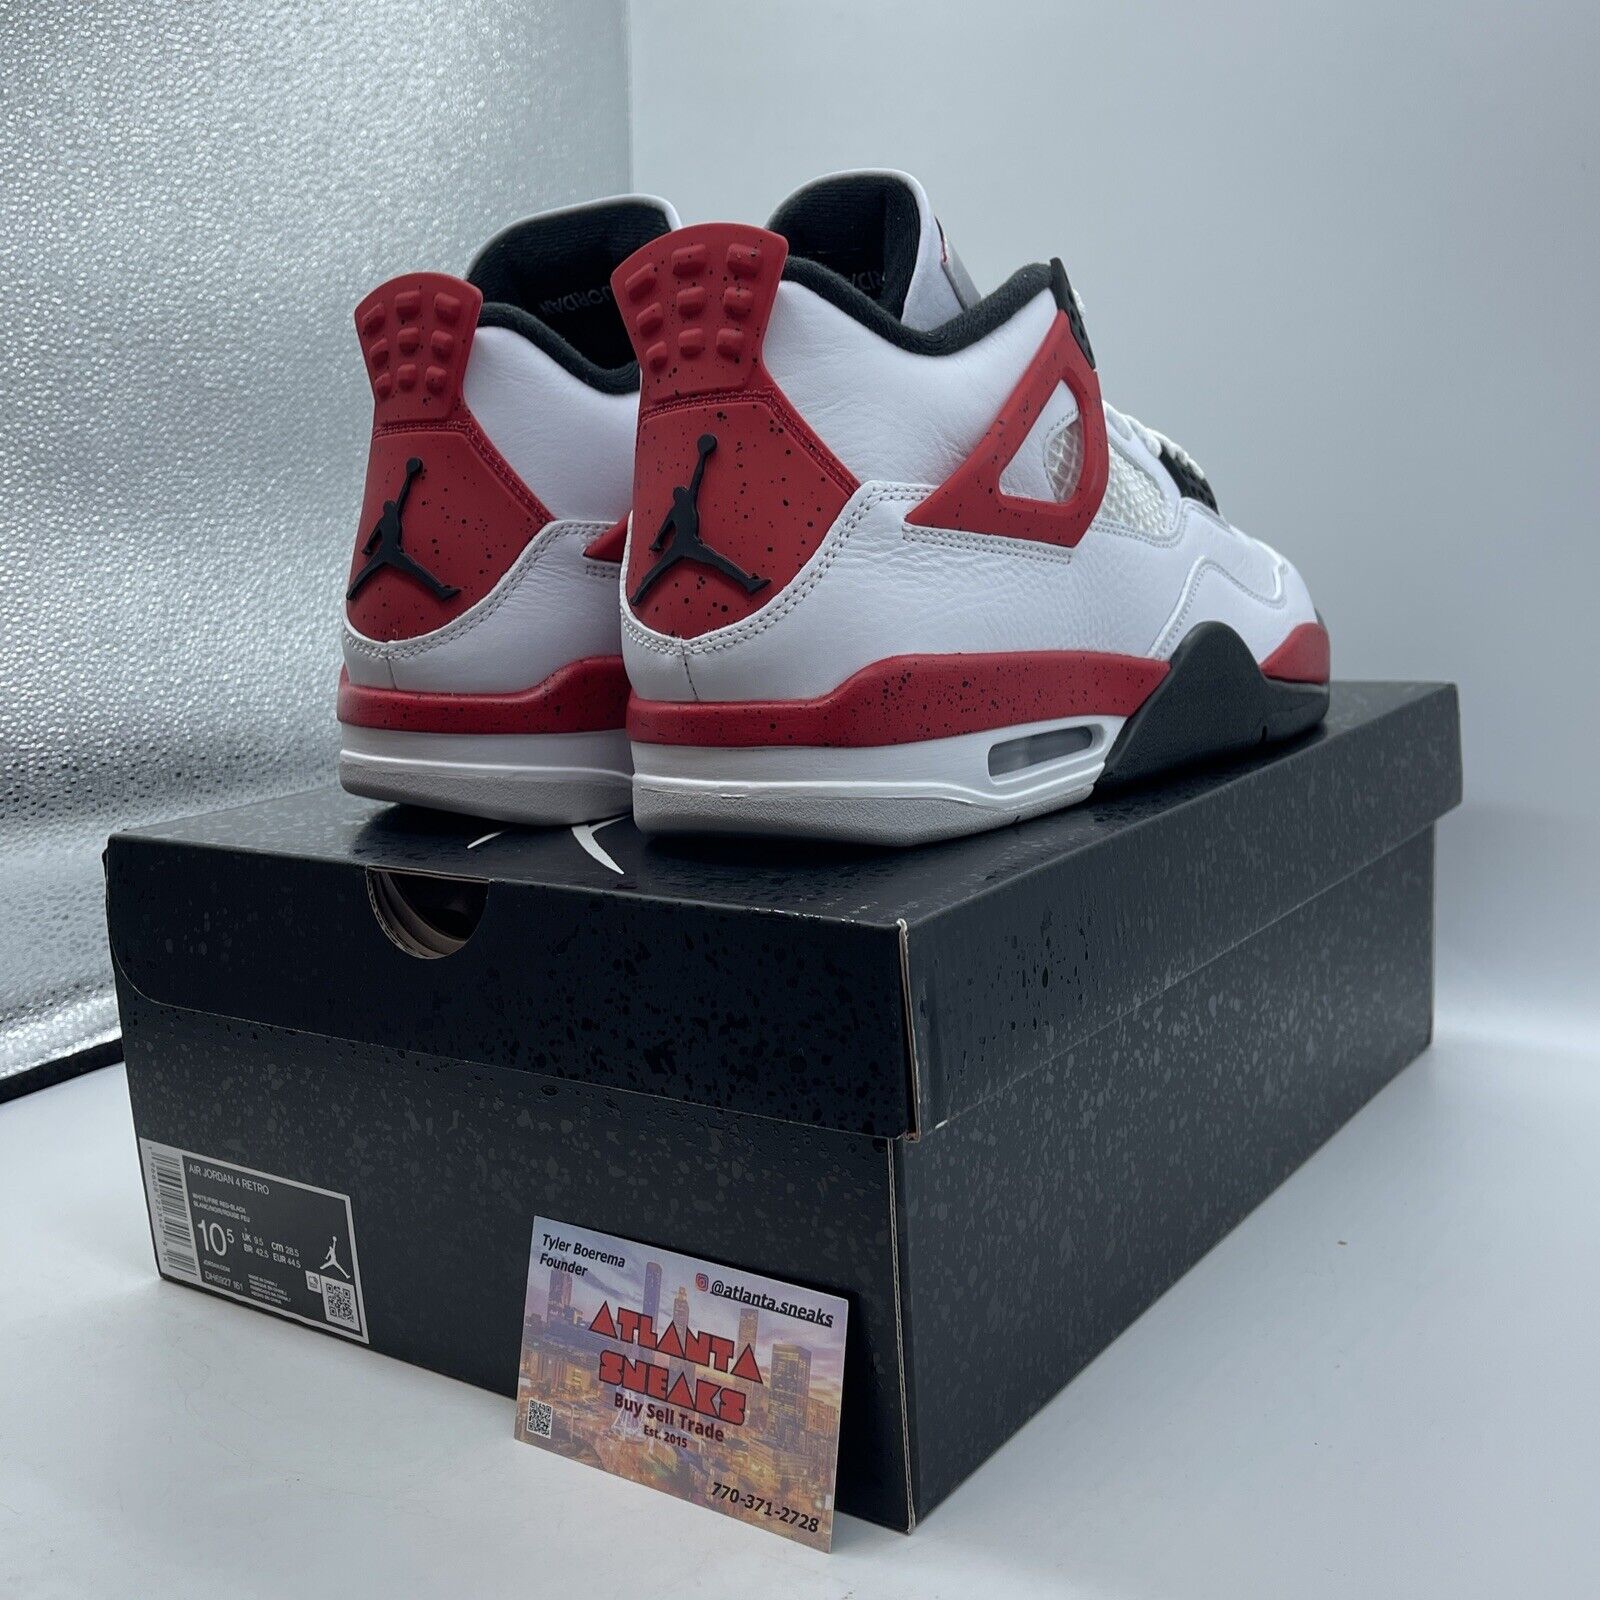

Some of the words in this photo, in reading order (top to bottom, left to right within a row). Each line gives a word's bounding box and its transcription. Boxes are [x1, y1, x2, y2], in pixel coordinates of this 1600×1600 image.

[189, 1164, 201, 1176] AIR
[203, 1168, 234, 1186] JORDAN
[235, 1178, 240, 1187] 4
[242, 1179, 270, 1195] RETRO
[242, 1232, 252, 1243] UK
[271, 1241, 284, 1252] cm
[243, 1243, 253, 1253] BR
[272, 1252, 286, 1264] EUR
[287, 1258, 301, 1269] 44.5
[542, 1233, 571, 1252] Tyler
[573, 1242, 626, 1268] Boerema
[539, 1253, 588, 1277] Founder
[710, 1280, 834, 1328] @atlanta.sneaks
[588, 1300, 763, 1384] ATLANTA
[599, 1350, 746, 1426] SNEAKS
[614, 1392, 643, 1418] Buy
[646, 1402, 674, 1426] Sell
[679, 1413, 724, 1442] Trade
[643, 1424, 661, 1441] Est.
[663, 1431, 688, 1448] 2015
[711, 1482, 819, 1533] 770-371-2728
